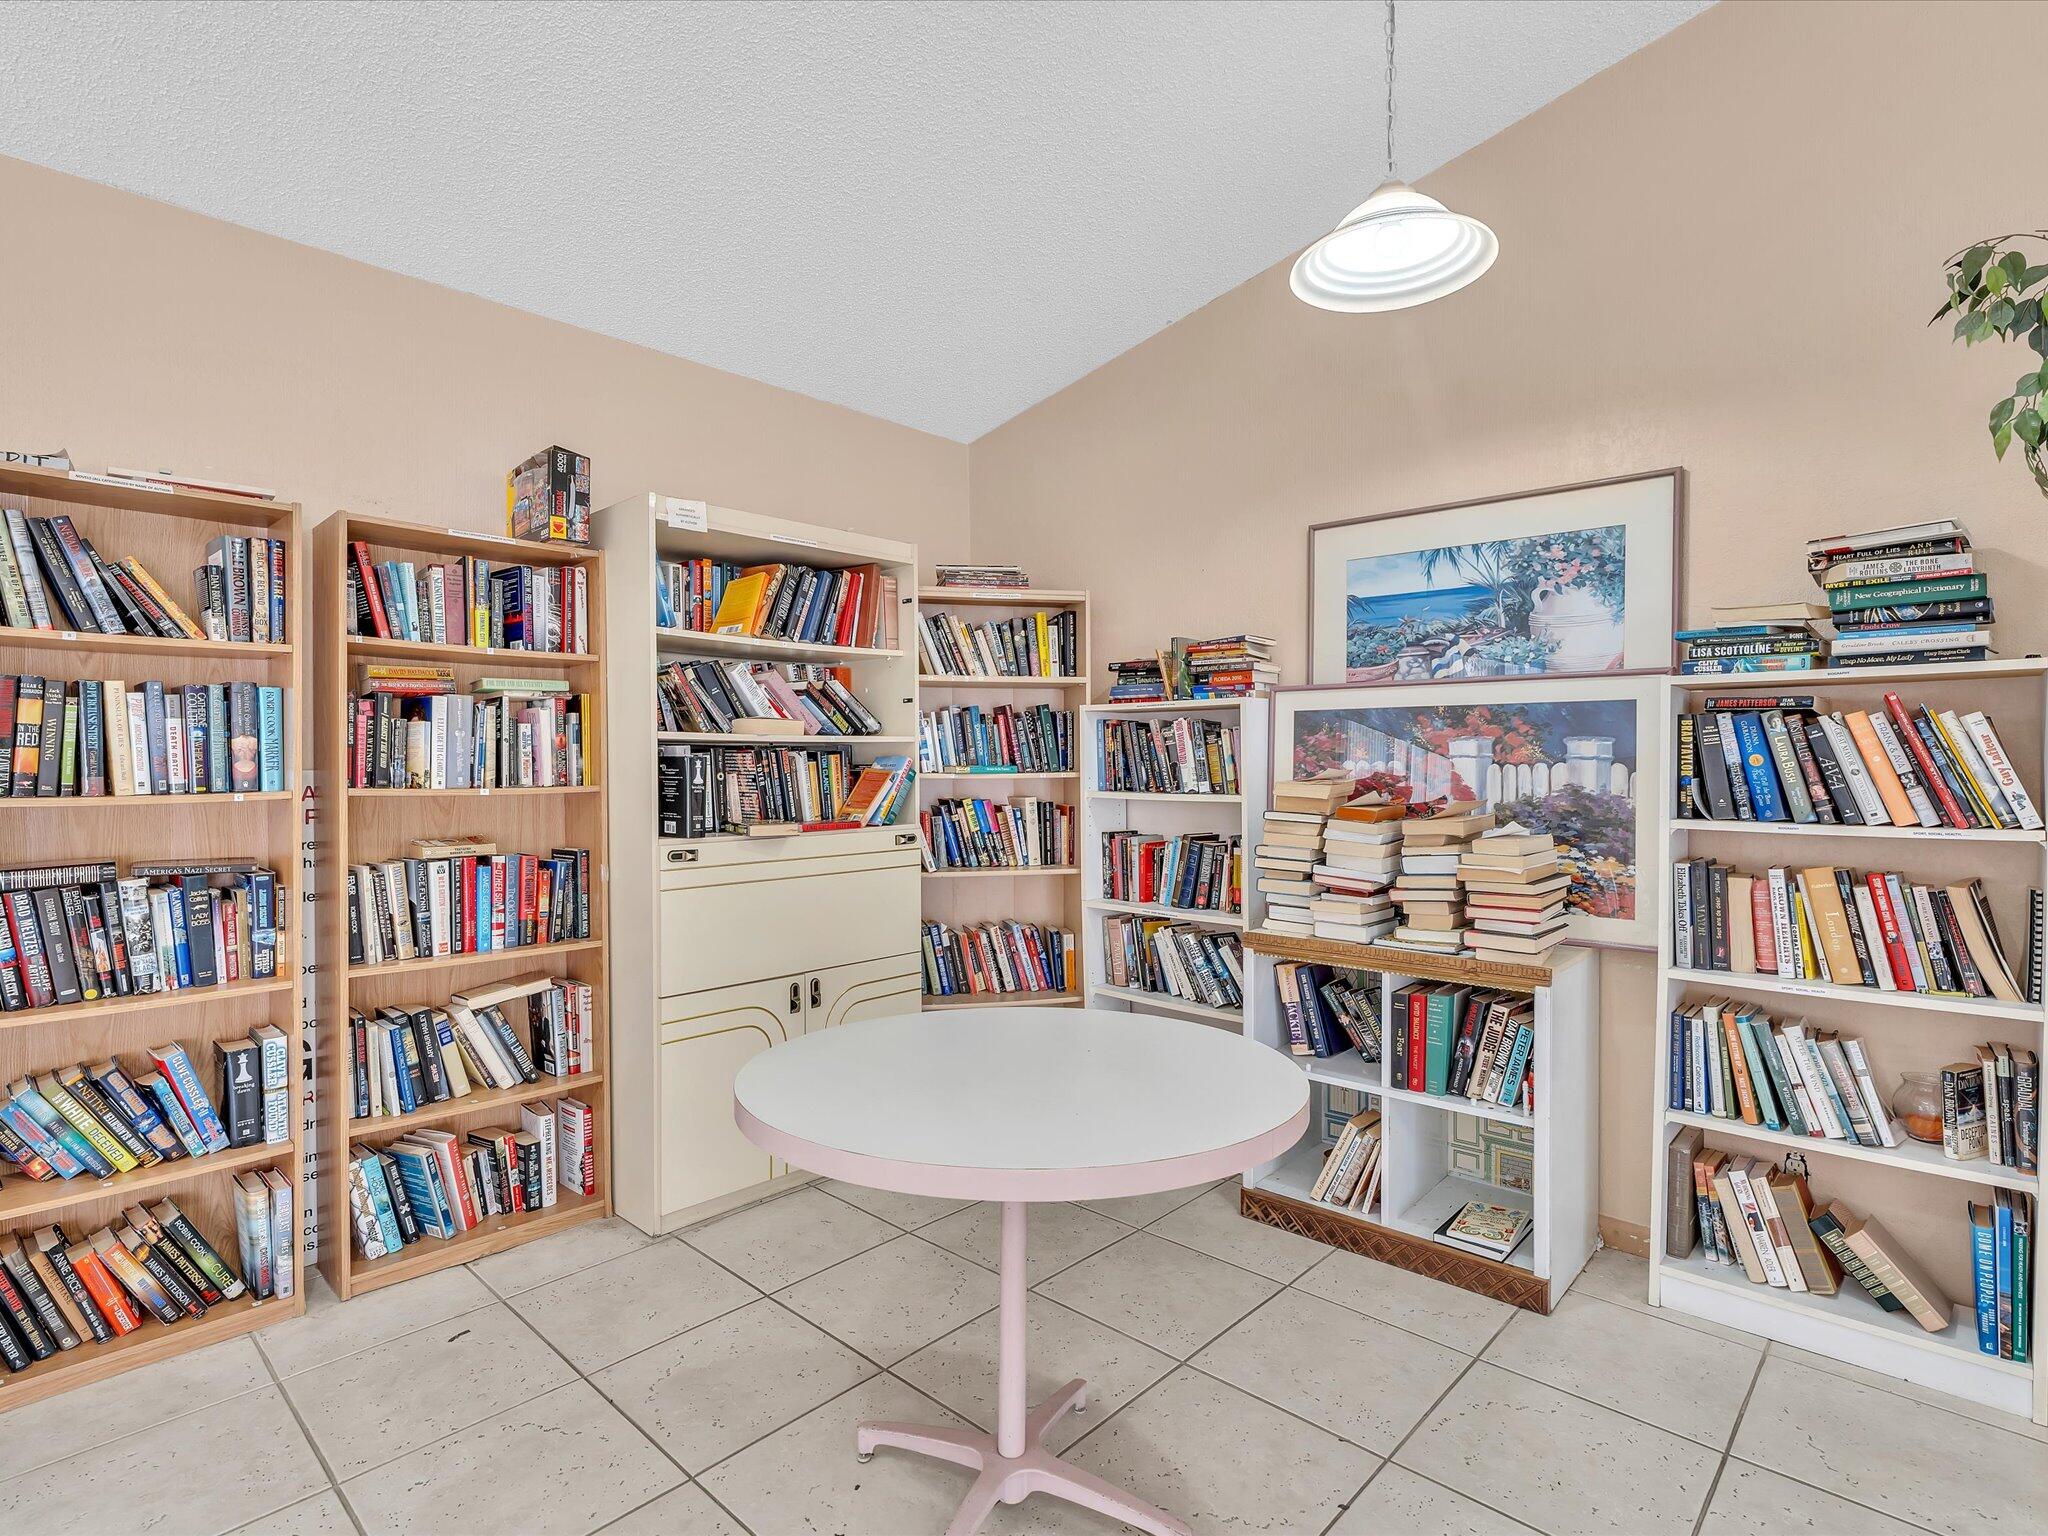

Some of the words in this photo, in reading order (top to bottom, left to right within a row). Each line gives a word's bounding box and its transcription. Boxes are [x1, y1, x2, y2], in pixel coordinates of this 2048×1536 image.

[57, 523, 81, 556] NEVADA
[77, 558, 95, 578] BARR
[231, 541, 244, 566] DALE
[1832, 552, 1855, 562] HEART
[1856, 550, 1874, 559] FULL
[1885, 546, 1901, 555] LIES
[1907, 547, 1936, 557] RULE
[1909, 541, 1933, 550] ANN
[256, 552, 266, 569] BACK
[273, 547, 284, 577] UNDER
[1859, 568, 1889, 577] ROLLINS
[1862, 562, 1885, 570] JAMES
[1903, 563, 1942, 573] LABYRINTH
[1905, 558, 1919, 566] THE
[1920, 557, 1939, 565] BONE
[210, 574, 220, 589] DAN
[232, 567, 246, 606] BROWN
[257, 570, 266, 579] OF
[211, 590, 222, 613] BROWN
[257, 580, 266, 606] BEYOND
[273, 579, 284, 600] FIRE
[1854, 591, 1872, 601] New
[1872, 586, 1922, 599] Geographical
[1923, 583, 1965, 593] Dictionary
[422, 598, 430, 611] KEN
[422, 611, 430, 637] FOLLETT
[1692, 646, 1712, 658] LISA
[1714, 643, 1772, 657] SCOTTOLINE
[187, 693, 198, 728] COULTER
[197, 693, 208, 728] CATHERINE
[265, 691, 275, 714] ROBIN
[44, 718, 57, 761] WINNING
[266, 716, 276, 738] COOK
[436, 717, 444, 753] ELIZABETH
[1680, 719, 1693, 743] BRAD
[1740, 720, 1754, 754] GABALDON
[1749, 725, 1759, 746] DIANA
[1787, 718, 1805, 743] KIRSTIE
[1876, 721, 1895, 747] FRANK
[194, 740, 204, 778] WHIPLASH
[265, 738, 280, 773] MARKER
[366, 737, 374, 772] WITNESS
[1680, 743, 1693, 777] TAYLOR
[1774, 735, 1791, 761] LAURA
[1794, 742, 1812, 762] ALLEY
[1887, 746, 1898, 755] &
[1898, 712, 1915, 738] BIBLICAL
[1910, 736, 1932, 768] FINANCIAL
[1927, 767, 1945, 790] STUDY
[1980, 734, 2007, 768] Lafleur
[436, 753, 445, 778] GEORGE
[1780, 760, 1797, 784] BUSH
[1890, 753, 1905, 770] AVA
[756, 763, 765, 787] TOYER
[822, 769, 830, 795] CLANCY
[893, 759, 912, 793] OUTLAWED
[1996, 767, 2016, 788] Guy
[9, 871, 25, 889] THE
[27, 867, 64, 888] BURDEN
[63, 866, 74, 885] OF
[73, 865, 101, 883] PROOF
[142, 868, 183, 876] AMERICA'S
[184, 866, 203, 874] NAZI
[392, 866, 404, 885] DAVID
[417, 862, 426, 886] VINCE
[1676, 867, 1688, 900] Elizabeth
[14, 893, 31, 917] BRAD
[62, 890, 75, 917] EISLER
[71, 889, 83, 915] BARRY
[394, 886, 407, 918] BALDACCI
[418, 887, 427, 912] FLYNN
[1776, 886, 1787, 920] CROWN
[1916, 889, 1925, 902] THE
[1677, 900, 1687, 920] Takes
[1695, 904, 1706, 936] MANOR
[1918, 901, 1930, 922] GREAT
[19, 919, 40, 957] MELTZER
[1678, 920, 1688, 934] Off
[1791, 925, 1800, 951] COMBAT
[1823, 910, 1842, 952] London
[1844, 903, 1862, 936] CROCODILE
[1853, 937, 1868, 961] ATTACK
[1923, 921, 1936, 941] GAME
[1183, 937, 1196, 962] CUSSLER
[1193, 942, 1204, 959] CLIVE
[1780, 922, 1792, 965] HEIGHTS
[1794, 953, 1802, 970] GOLF
[1, 967, 16, 982] LOST
[27, 964, 40, 988] ARTIST
[4, 982, 19, 997] CITY
[1284, 1002, 1303, 1039] JACKIE
[1308, 1008, 1317, 1027] LUCKY
[1489, 1009, 1506, 1027] THE
[1503, 1018, 1518, 1037] DAN
[1312, 1027, 1320, 1040] YOU
[1482, 1025, 1501, 1055] JUDGE
[1515, 1027, 1530, 1058] PETER
[500, 1024, 518, 1045] CASH
[510, 1044, 534, 1074] LANDING
[1493, 1037, 1513, 1067] BROWN
[266, 1043, 278, 1087] CUSSLER
[275, 1047, 286, 1078] CLIVE
[1481, 1055, 1491, 1070] STEVE
[1506, 1056, 1523, 1086] JAMES
[1793, 1034, 1806, 1057] AFTER
[1803, 1057, 1812, 1071] THE
[1809, 1073, 1821, 1093] WIND
[171, 1055, 189, 1078] CLIVE
[180, 1078, 205, 1111] CUSSLER
[1476, 1069, 1488, 1088] MARTINI
[1943, 1081, 1955, 1099] DAN
[78, 1085, 109, 1116] FALLEN
[2016, 1075, 2033, 1112] GRADUAL
[267, 1101, 278, 1132] FOUND
[277, 1093, 288, 1137] ATLANTIS
[1944, 1098, 1956, 1124] BROWN
[2001, 1098, 2012, 1123] speak
[59, 1099, 95, 1130] WHITE
[88, 1127, 125, 1162] DECEIVED
[103, 1111, 131, 1141] SLAUGHTER
[1960, 1128, 1988, 1142] DECEPTION
[2022, 1120, 2031, 1146] Christopher
[126, 1139, 144, 1155] KARIN
[1968, 1138, 1984, 1150] POINT
[2023, 1145, 2031, 1159] Priest
[370, 1176, 380, 1197] HOAG
[377, 1175, 385, 1192] TAMI
[1740, 1179, 1752, 1202] MOURNING
[174, 1219, 195, 1240] ROBIN
[186, 1238, 208, 1257] COOK
[209, 1262, 235, 1289] CURE
[1754, 1232, 1770, 1256] WARREN
[1763, 1257, 1777, 1273] ADLER
[1976, 1231, 1994, 1256] COME
[157, 1237, 183, 1258] JAMES
[175, 1257, 208, 1292] PATTERSON
[1978, 1258, 1994, 1271] ON
[42, 1262, 59, 1282] PAPER
[57, 1281, 73, 1305] CHASE
[144, 1257, 170, 1279] JAMES
[161, 1277, 190, 1306] PATTERSON
[1979, 1271, 1995, 1306] PEOPLE
